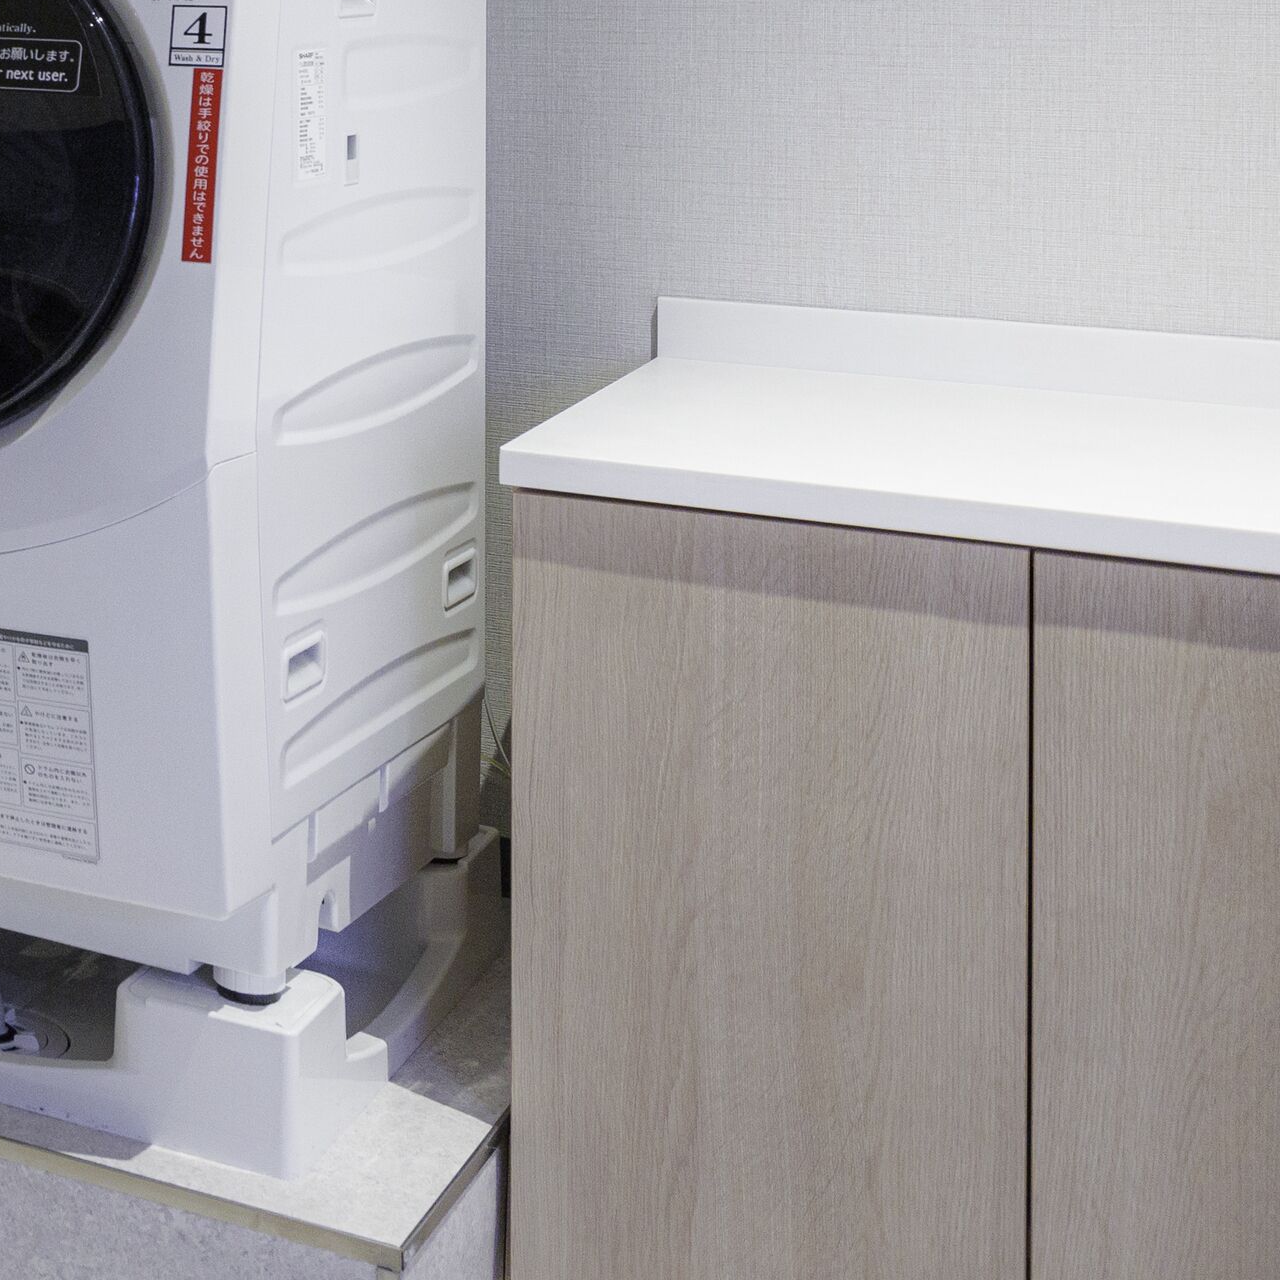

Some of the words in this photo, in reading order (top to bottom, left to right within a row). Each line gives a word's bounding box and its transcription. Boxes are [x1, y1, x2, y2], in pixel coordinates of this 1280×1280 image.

[183, 12, 213, 44] 4
[174, 54, 193, 62] Wash
[205, 55, 220, 64] Dry
[5, 69, 34, 81] next
[38, 71, 68, 82] user.
[190, 72, 215, 260] 乾燥は手絞りでの使用はできません
